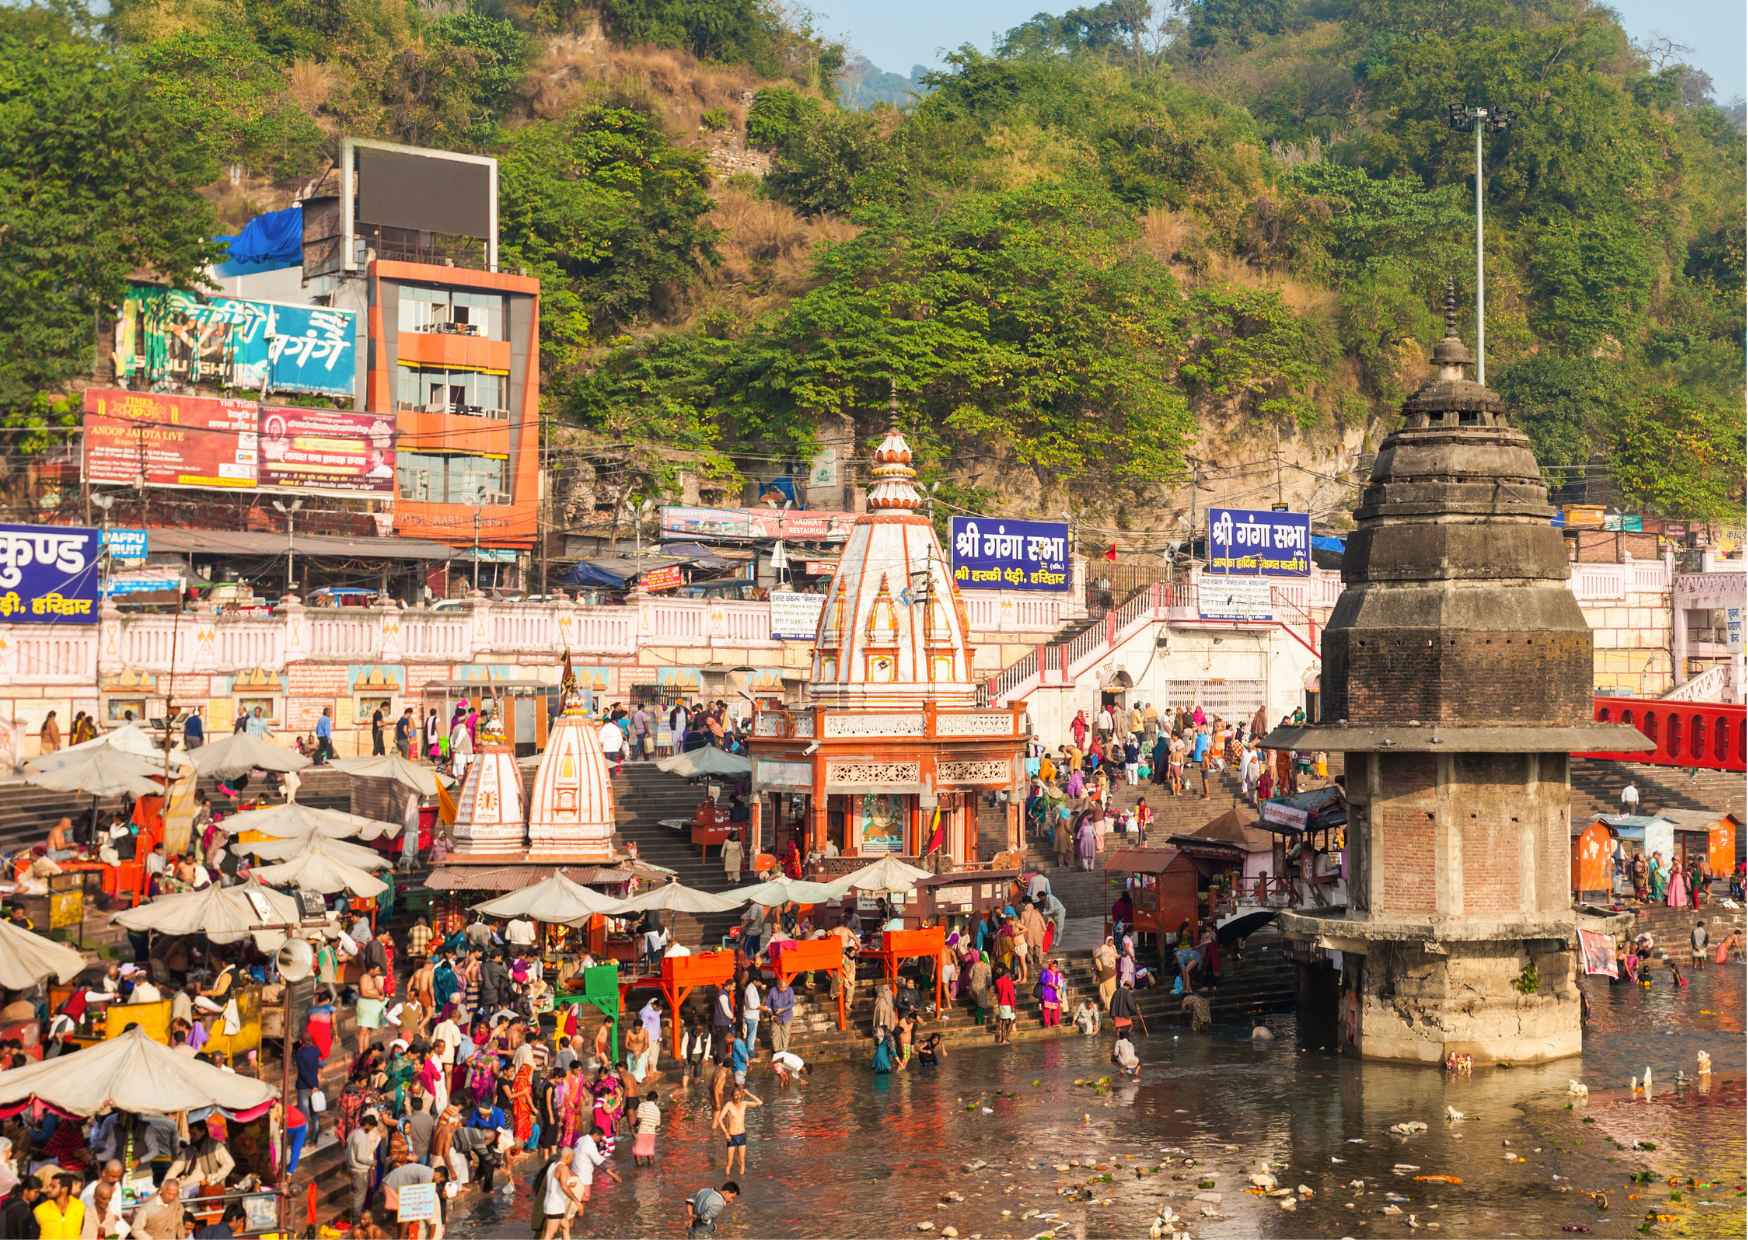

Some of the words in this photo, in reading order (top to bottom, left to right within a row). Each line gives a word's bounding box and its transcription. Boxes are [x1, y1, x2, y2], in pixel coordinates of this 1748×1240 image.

[162, 431, 185, 441] LIVE
[1213, 511, 1234, 546] श्री
[1236, 514, 1271, 548] गंगा
[1273, 524, 1306, 549] सभा
[955, 522, 980, 558] श्री
[983, 525, 1024, 560] गंगा
[1027, 535, 1065, 562] सभा
[1030, 569, 1066, 585] हरिद्वार
[32, 593, 93, 616] हरिद्वार
